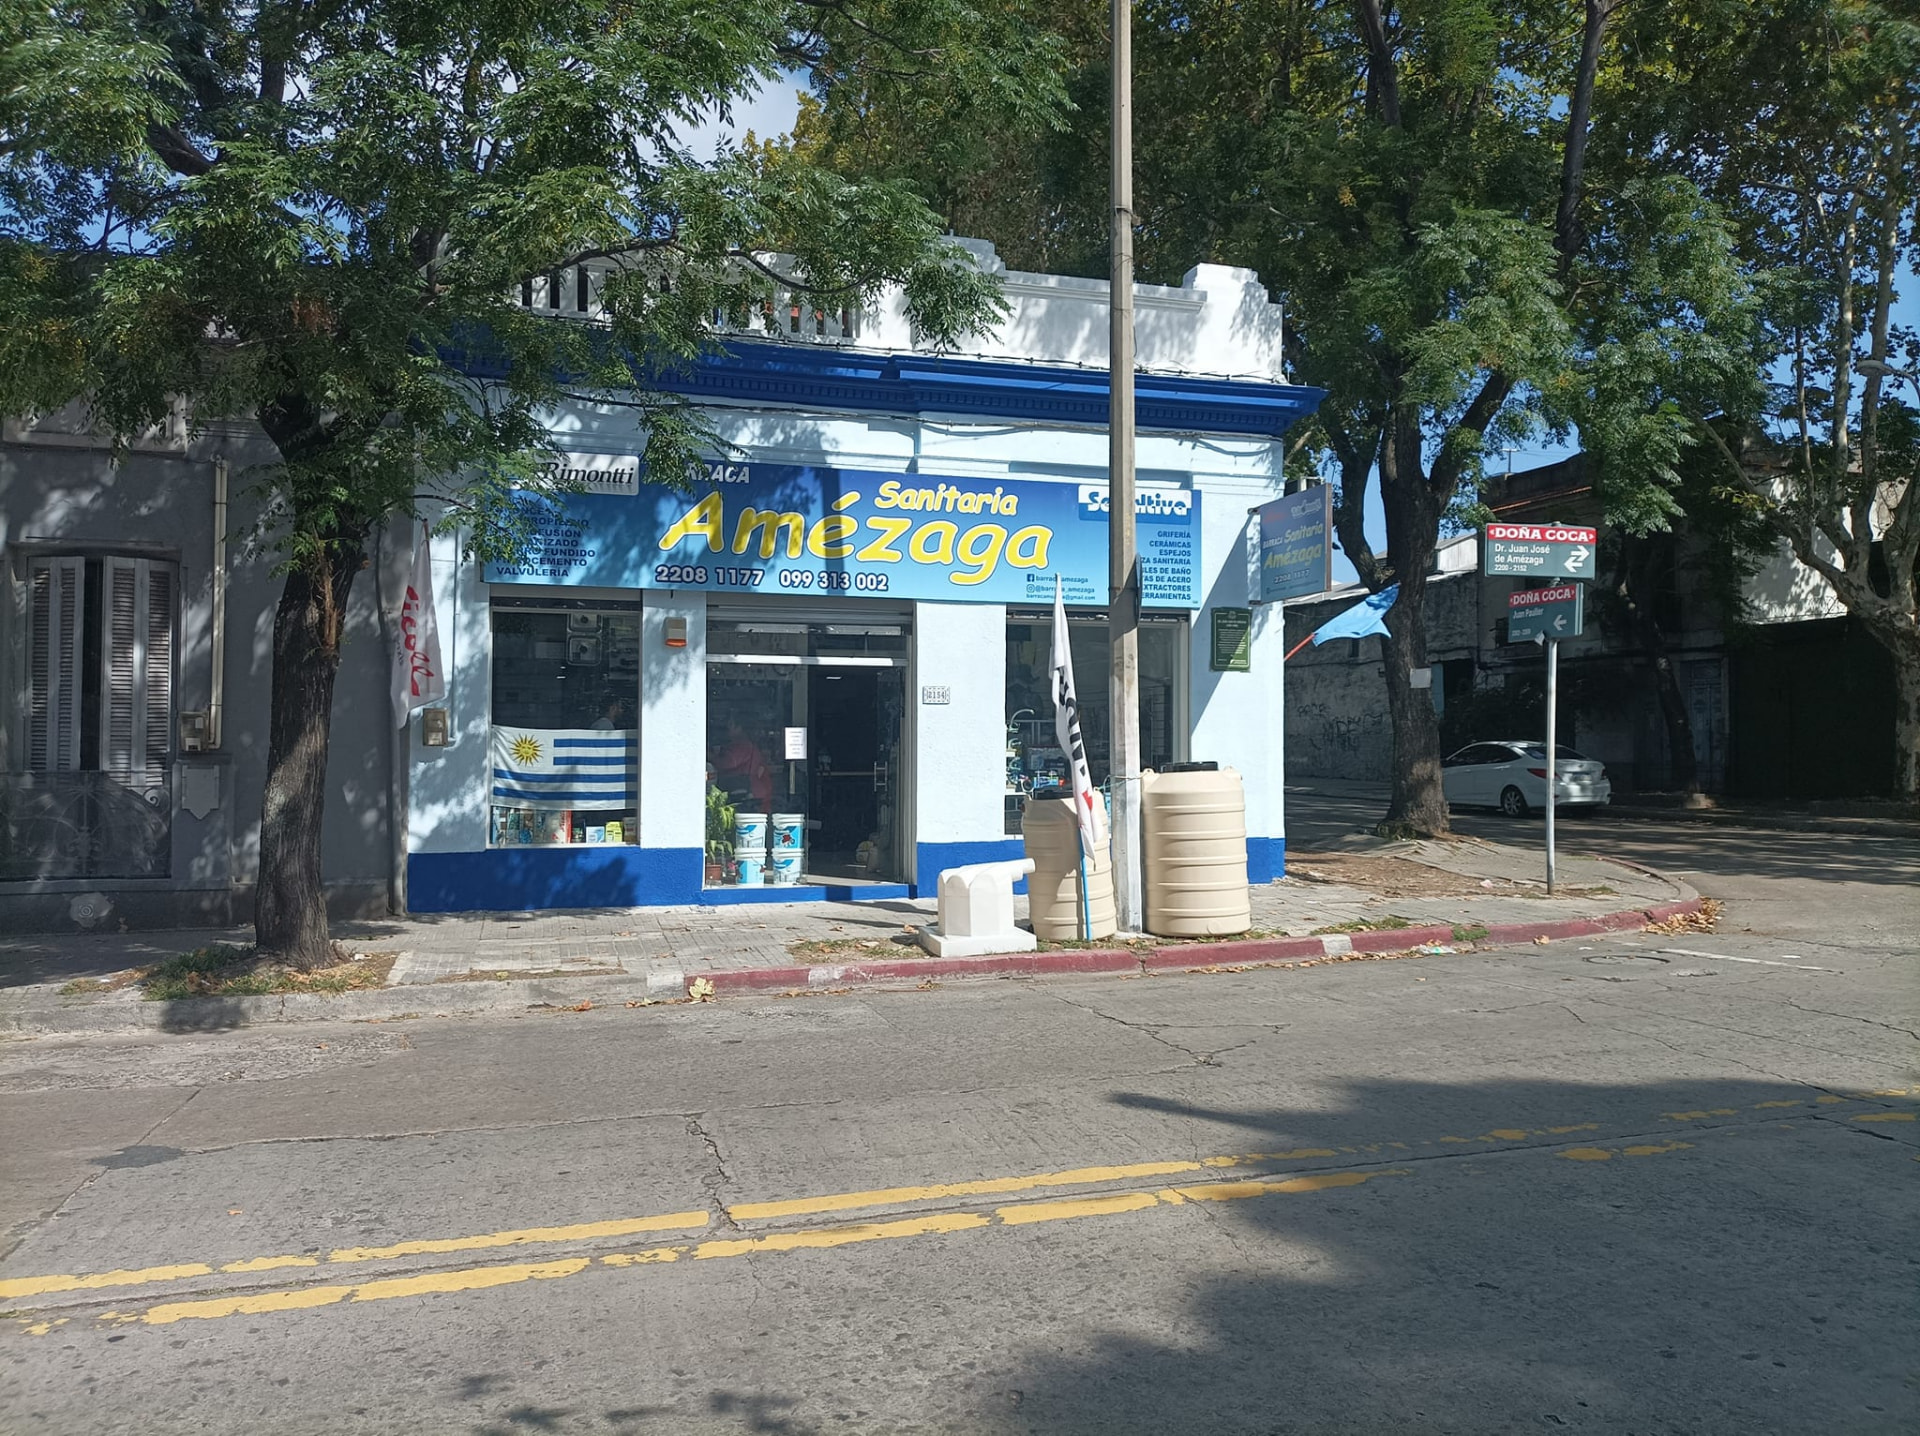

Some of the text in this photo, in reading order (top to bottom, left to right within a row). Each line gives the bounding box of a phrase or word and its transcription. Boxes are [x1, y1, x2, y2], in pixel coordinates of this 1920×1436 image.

[543, 462, 635, 485] Rimontti
[874, 480, 1019, 517] Sanitaria
[1157, 530, 1191, 538] GRIFERÍA
[1284, 520, 1323, 543] Sanitaria
[1495, 527, 1589, 542] DOÑA COCA
[658, 489, 1053, 586] Amézaga
[1149, 540, 1191, 549] CERÁMICAS
[1495, 543, 1550, 554] Dr. Juan José
[545, 548, 596, 558] FUNDIDO
[1159, 549, 1191, 557] ESPEJOS
[1264, 543, 1322, 571] Amézaga
[1153, 557, 1191, 565] SANITARIA
[1494, 554, 1544, 566] de Amézaga
[496, 566, 569, 577] VALVULERÍA
[1171, 566, 1191, 575] BAÑO
[655, 564, 889, 592] 2208 1177 099 313 002
[1143, 584, 1191, 592] XTRACTORES
[1513, 588, 1571, 605] DOÑA COCA
